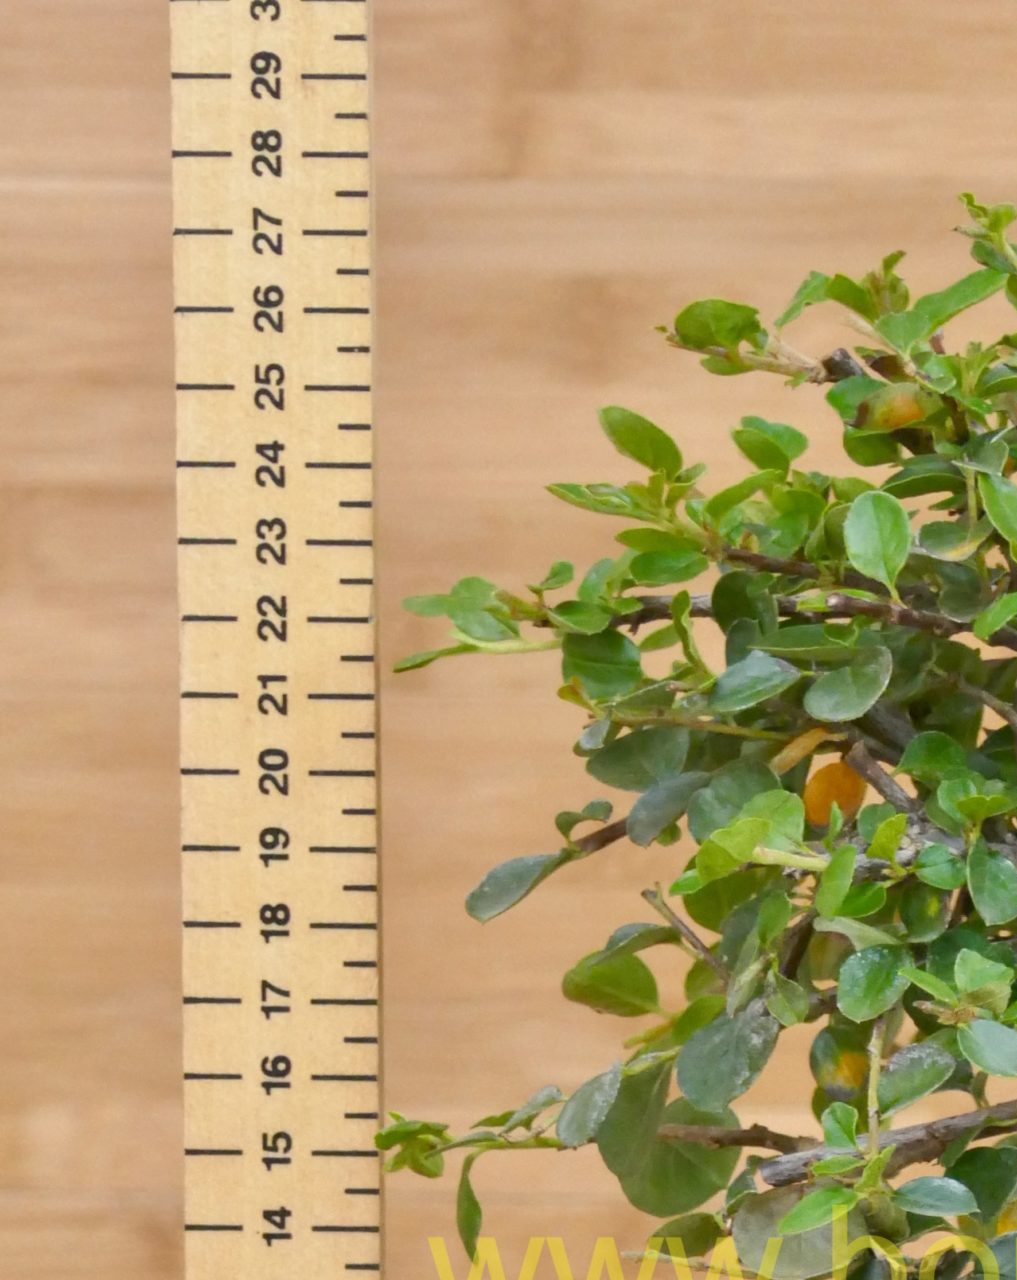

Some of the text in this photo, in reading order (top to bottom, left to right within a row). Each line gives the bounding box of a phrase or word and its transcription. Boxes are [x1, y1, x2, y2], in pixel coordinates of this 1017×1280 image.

[250, 51, 281, 100] 29
[251, 129, 282, 177] 28
[252, 207, 282, 255] 27
[253, 285, 284, 333] 26
[254, 363, 285, 411] 25
[255, 440, 285, 488] 24
[255, 517, 287, 565] 23
[256, 595, 287, 642] 22
[257, 674, 288, 716] 21
[258, 748, 289, 796] 20
[259, 827, 290, 868] 19
[259, 903, 291, 944] 18
[260, 979, 290, 1019] 17
[261, 1055, 292, 1096] 16
[261, 1131, 292, 1171] 15
[262, 1206, 292, 1247] 14
